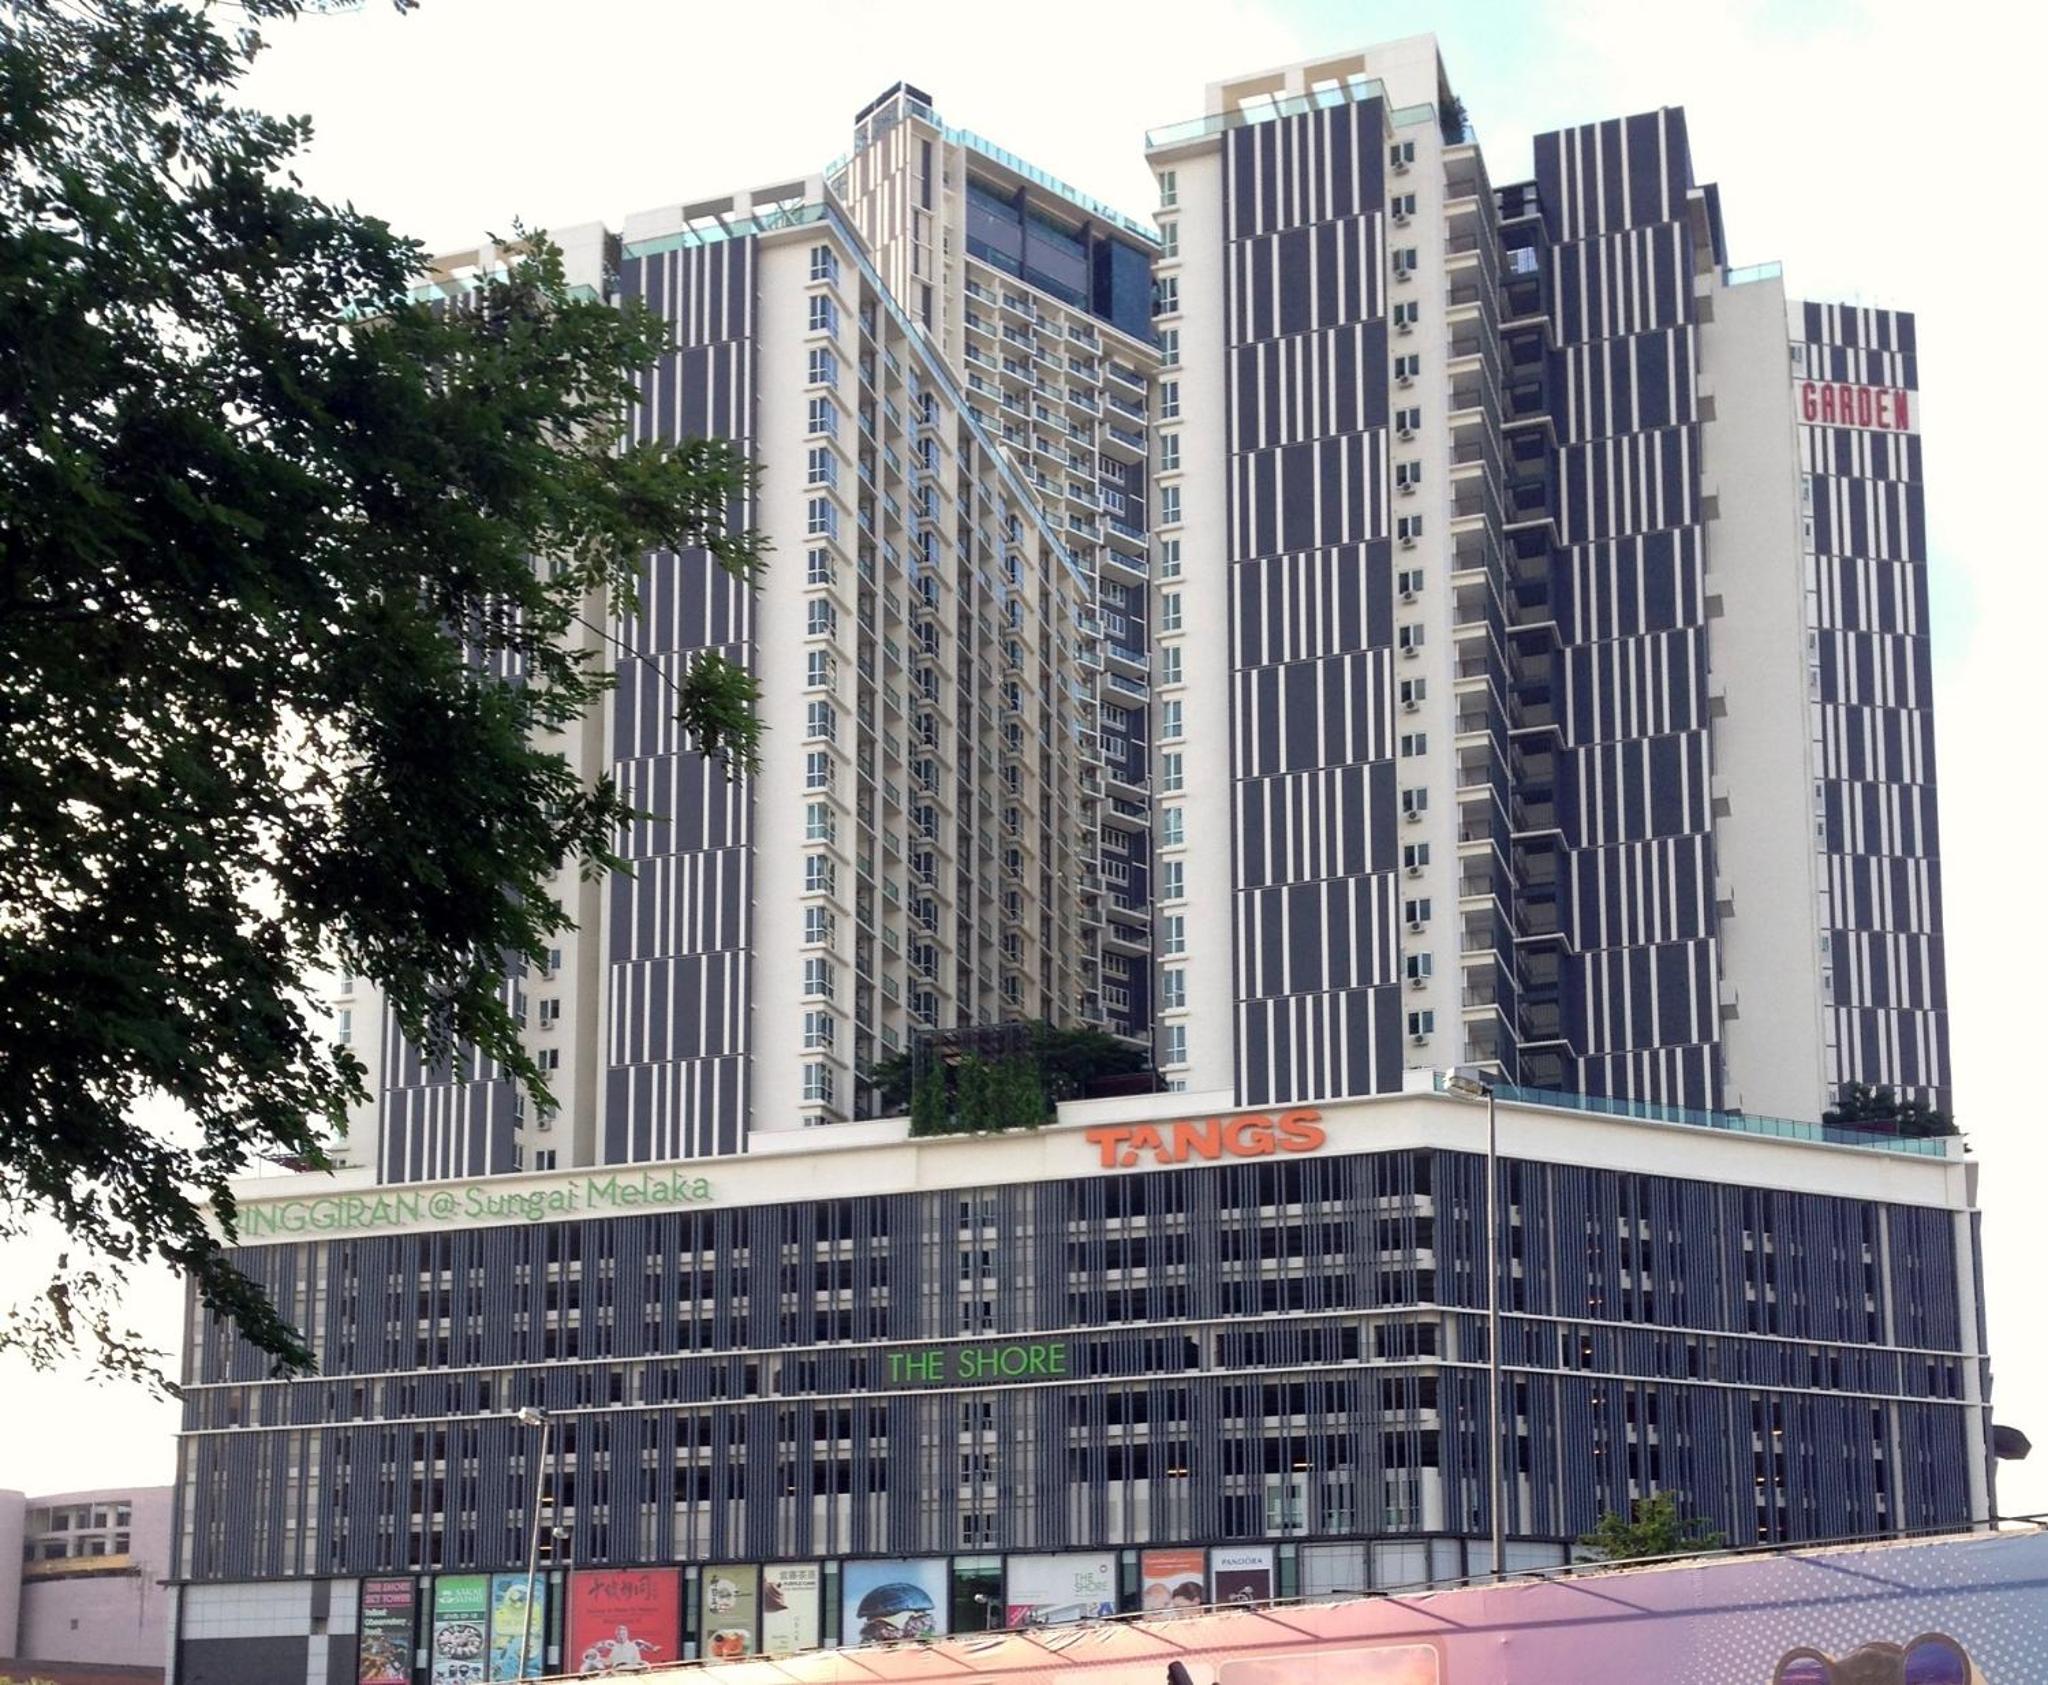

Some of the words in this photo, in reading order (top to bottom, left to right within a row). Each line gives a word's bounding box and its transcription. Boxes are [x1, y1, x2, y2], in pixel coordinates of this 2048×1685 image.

[1802, 381, 1909, 430] GARDEN
[1086, 1108, 1326, 1168] TANGS
[235, 1191, 420, 1236] INGGIRAN
[464, 1180, 576, 1221] Sungai
[587, 1168, 712, 1208] Melaka
[887, 1351, 945, 1382] THE
[958, 1343, 1066, 1378] SHORE
[1074, 1572, 1095, 1583] THE
[1221, 1557, 1263, 1566] PANDORA
[1073, 1582, 1109, 1593] SHORE
